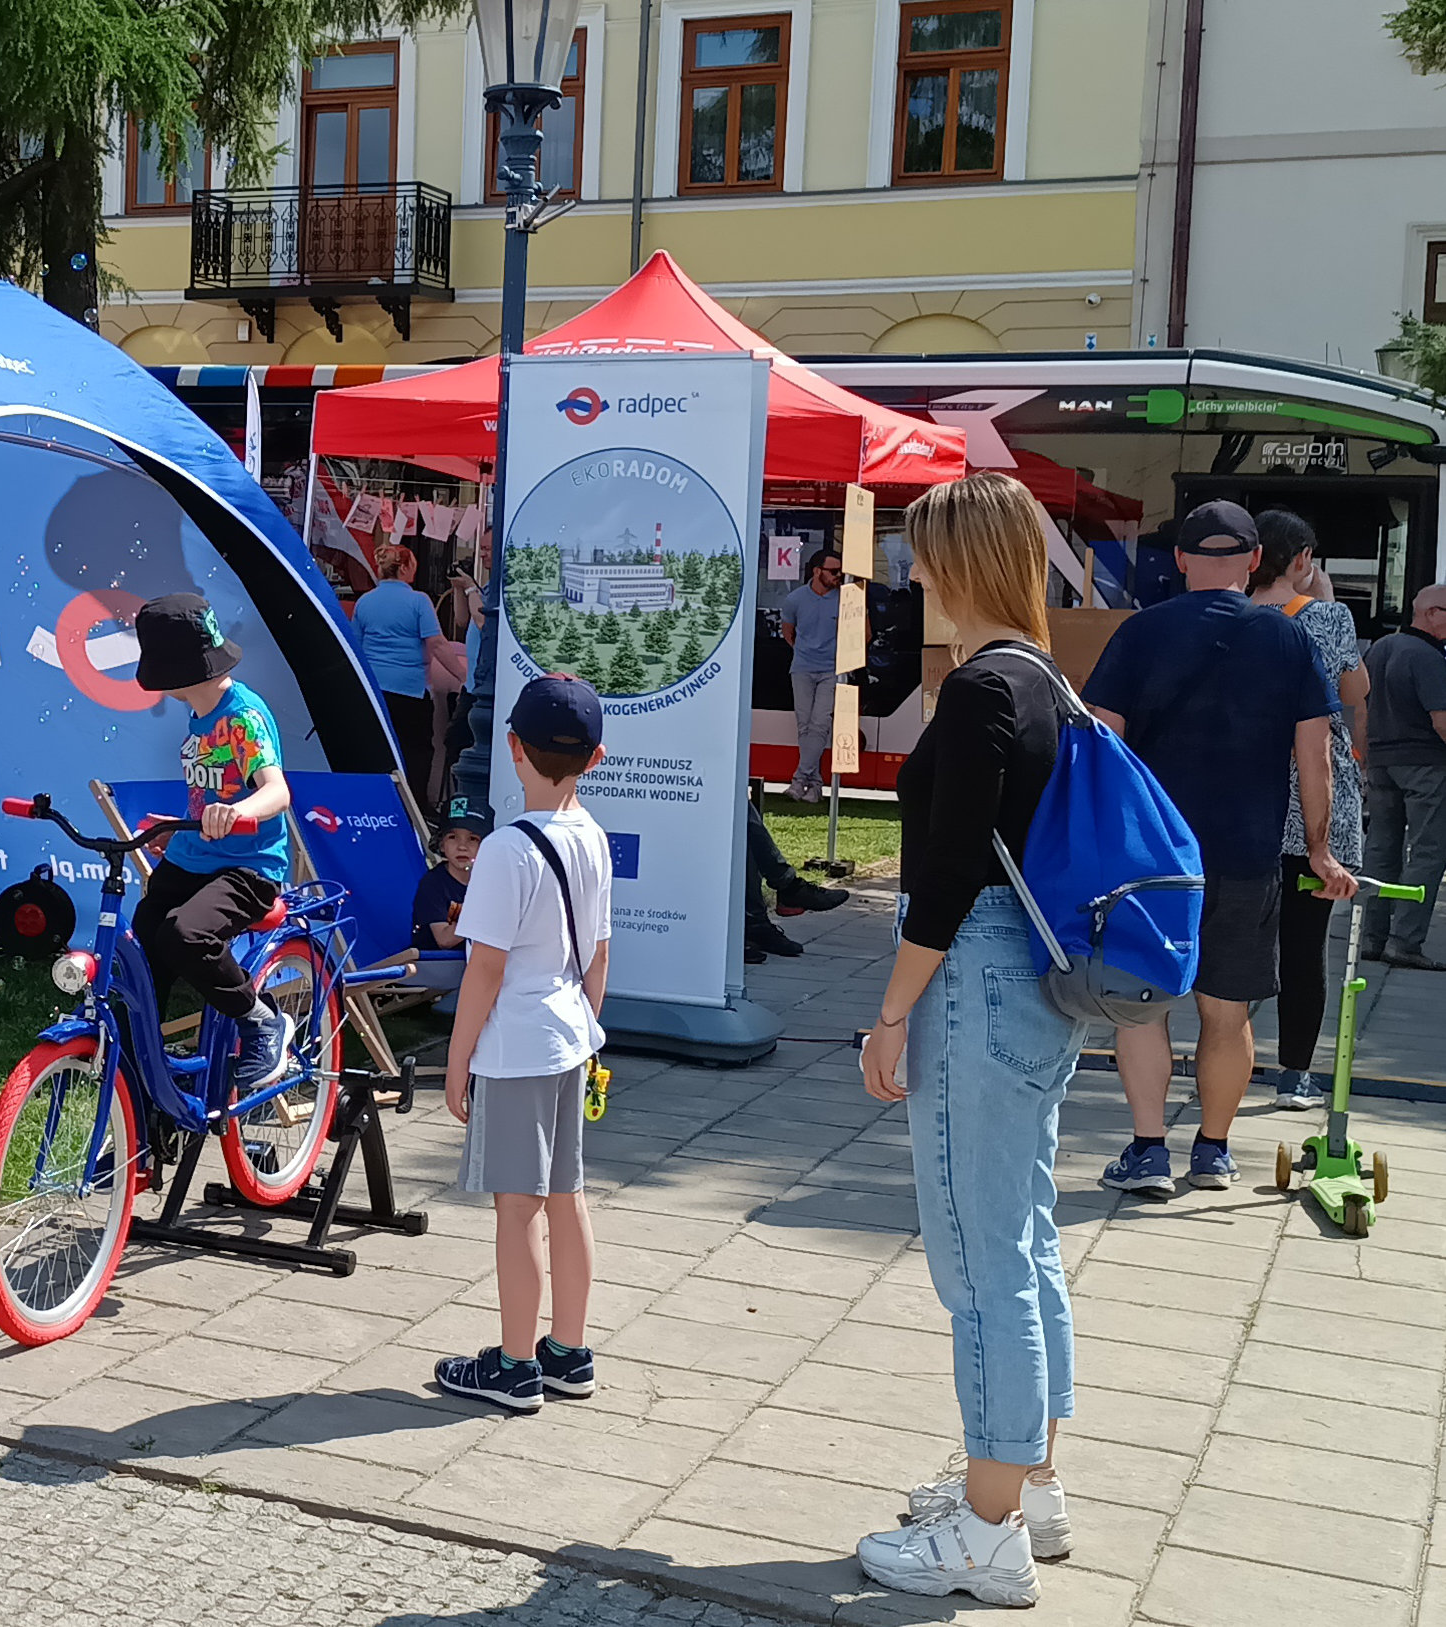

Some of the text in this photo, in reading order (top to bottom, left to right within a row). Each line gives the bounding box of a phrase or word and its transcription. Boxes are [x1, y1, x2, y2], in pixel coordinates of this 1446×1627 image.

[617, 393, 688, 417] radpec
[1058, 400, 1113, 411] MAN
[777, 548, 793, 567] K
[603, 661, 722, 716] KOGENERACYJNEGO
[600, 755, 693, 771] DOWY FUNDUSZ
[625, 769, 704, 787] ŚRODOWISKA
[649, 790, 700, 803] WODNEJ
[347, 813, 398, 831] radpec
[647, 908, 687, 921] środków
[611, 920, 670, 934] nizacyjnego
